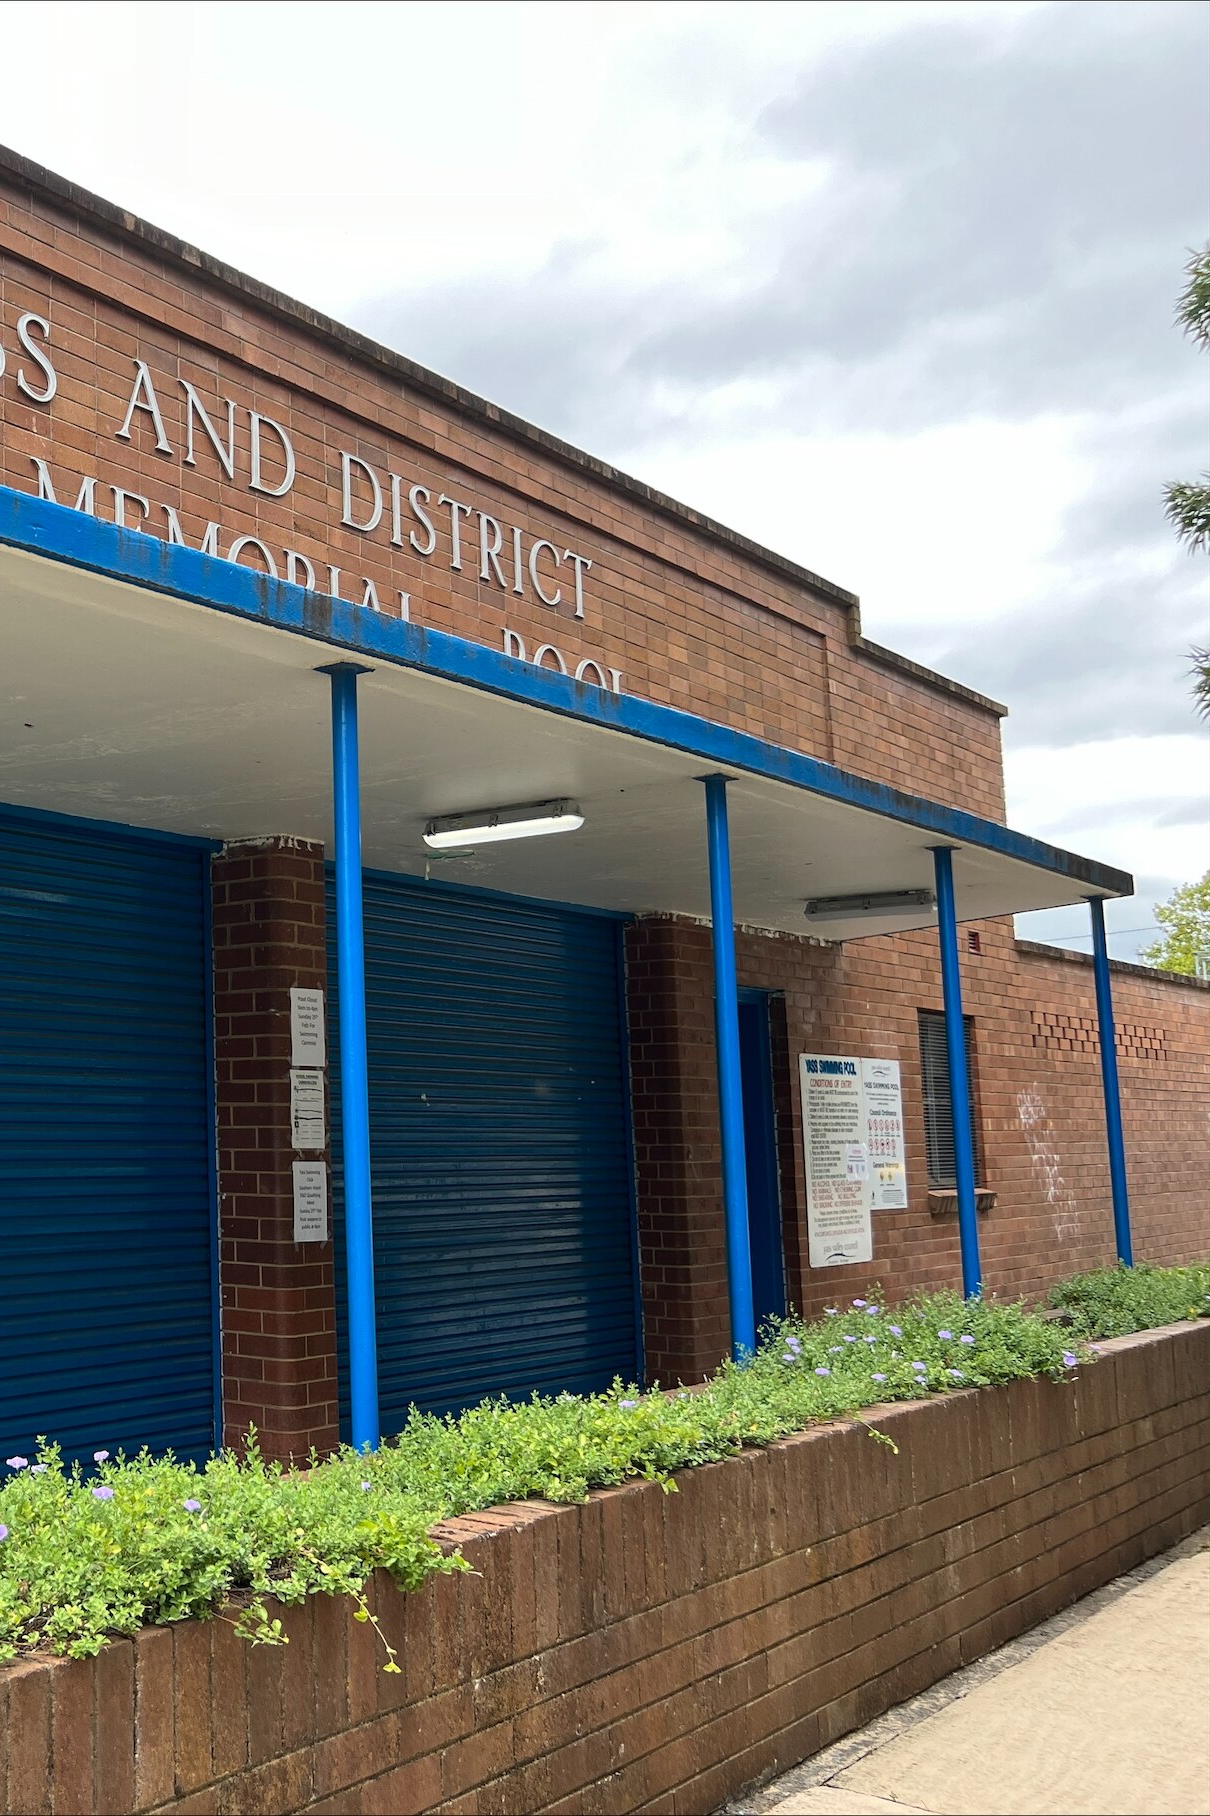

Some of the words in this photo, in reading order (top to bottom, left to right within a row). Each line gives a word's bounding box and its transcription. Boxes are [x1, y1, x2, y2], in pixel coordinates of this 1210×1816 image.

[115, 360, 295, 496] AND
[340, 451, 592, 618] DISTRICT
[805, 1059, 818, 1073] YASS
[819, 1060, 843, 1075] SWIMMING
[844, 1062, 856, 1076] POOL
